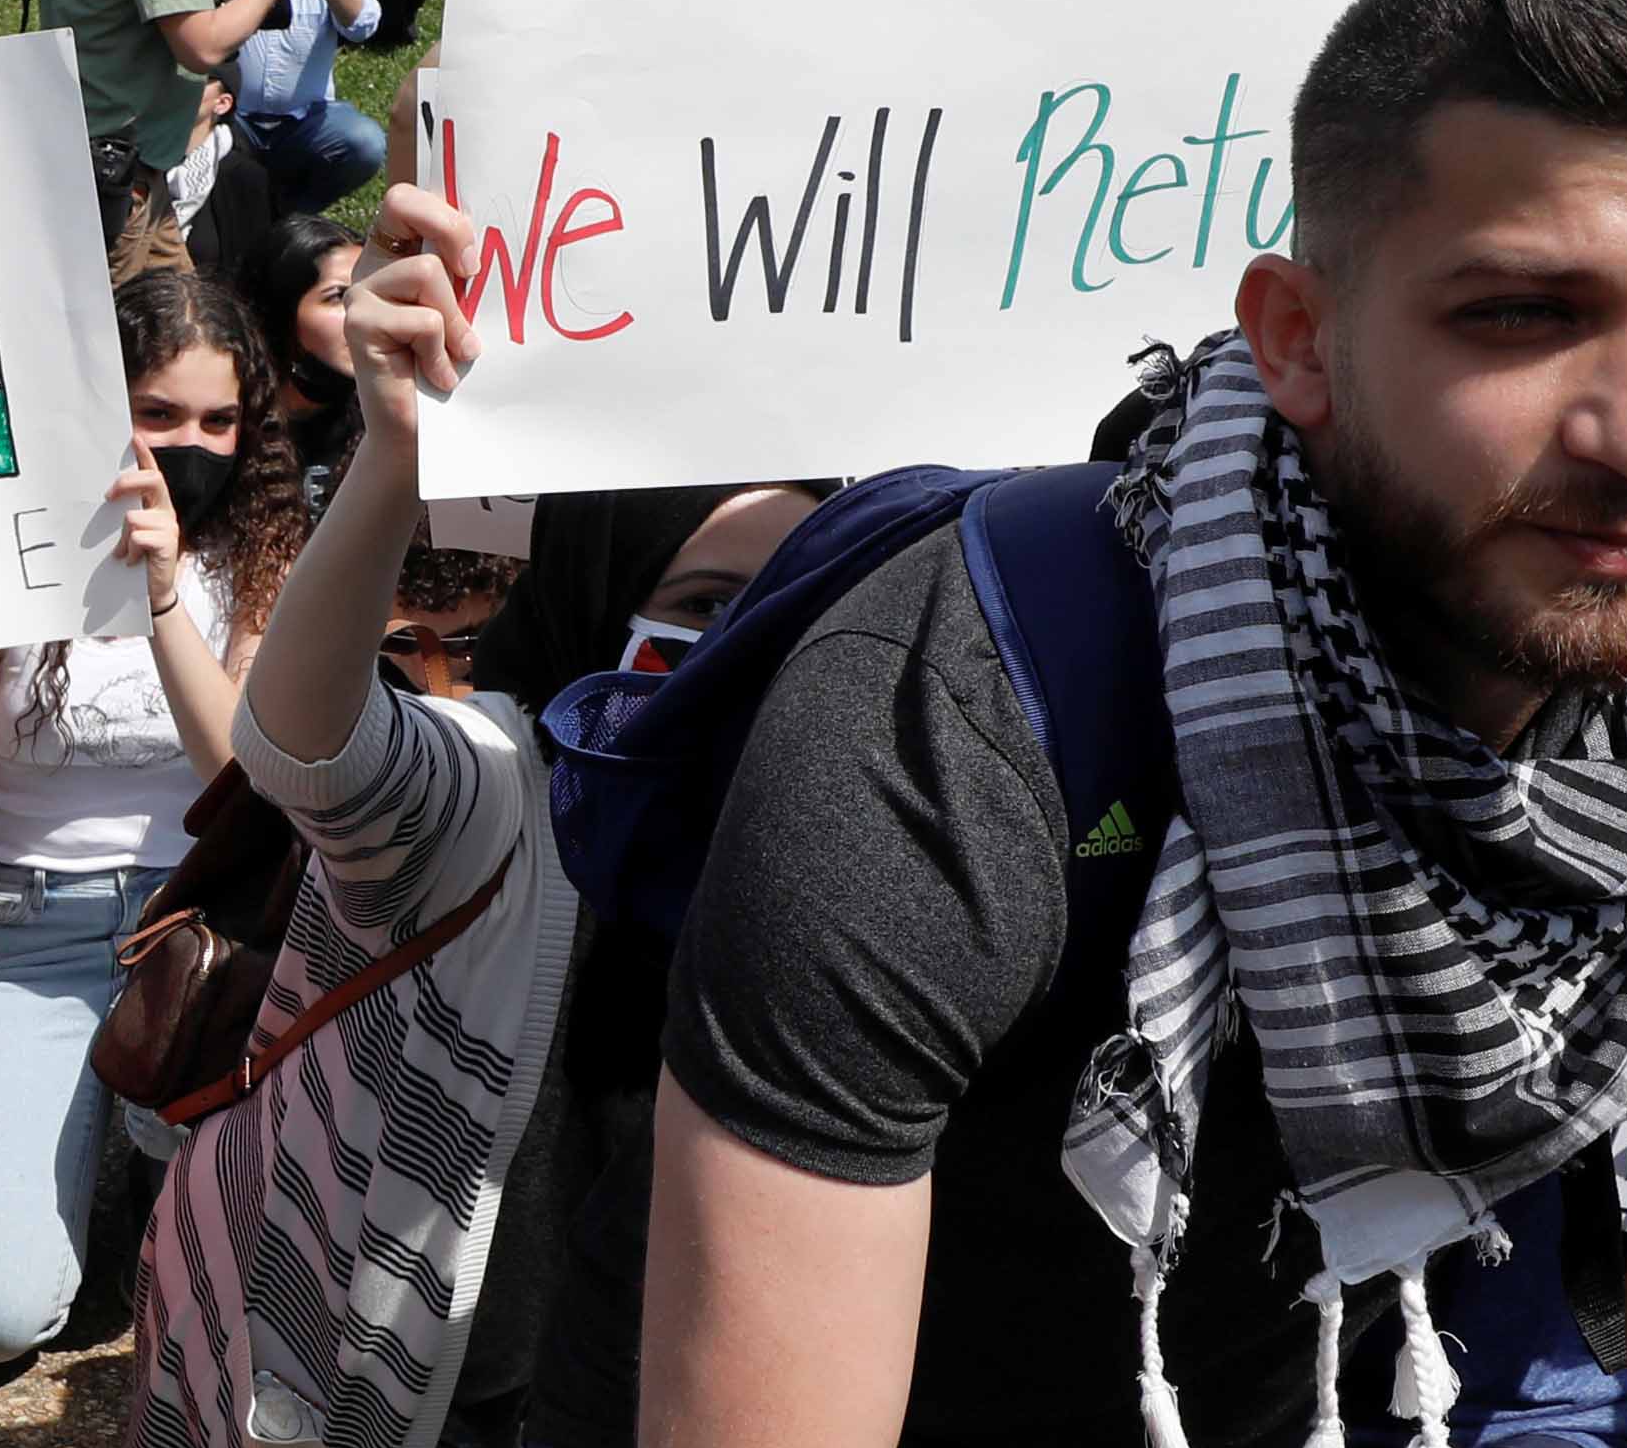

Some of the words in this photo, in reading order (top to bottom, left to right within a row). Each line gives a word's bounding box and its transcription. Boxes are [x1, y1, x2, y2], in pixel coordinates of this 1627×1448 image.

[442, 117, 635, 346] We
[700, 105, 943, 343] Will
[1075, 835, 1144, 858] adidas
